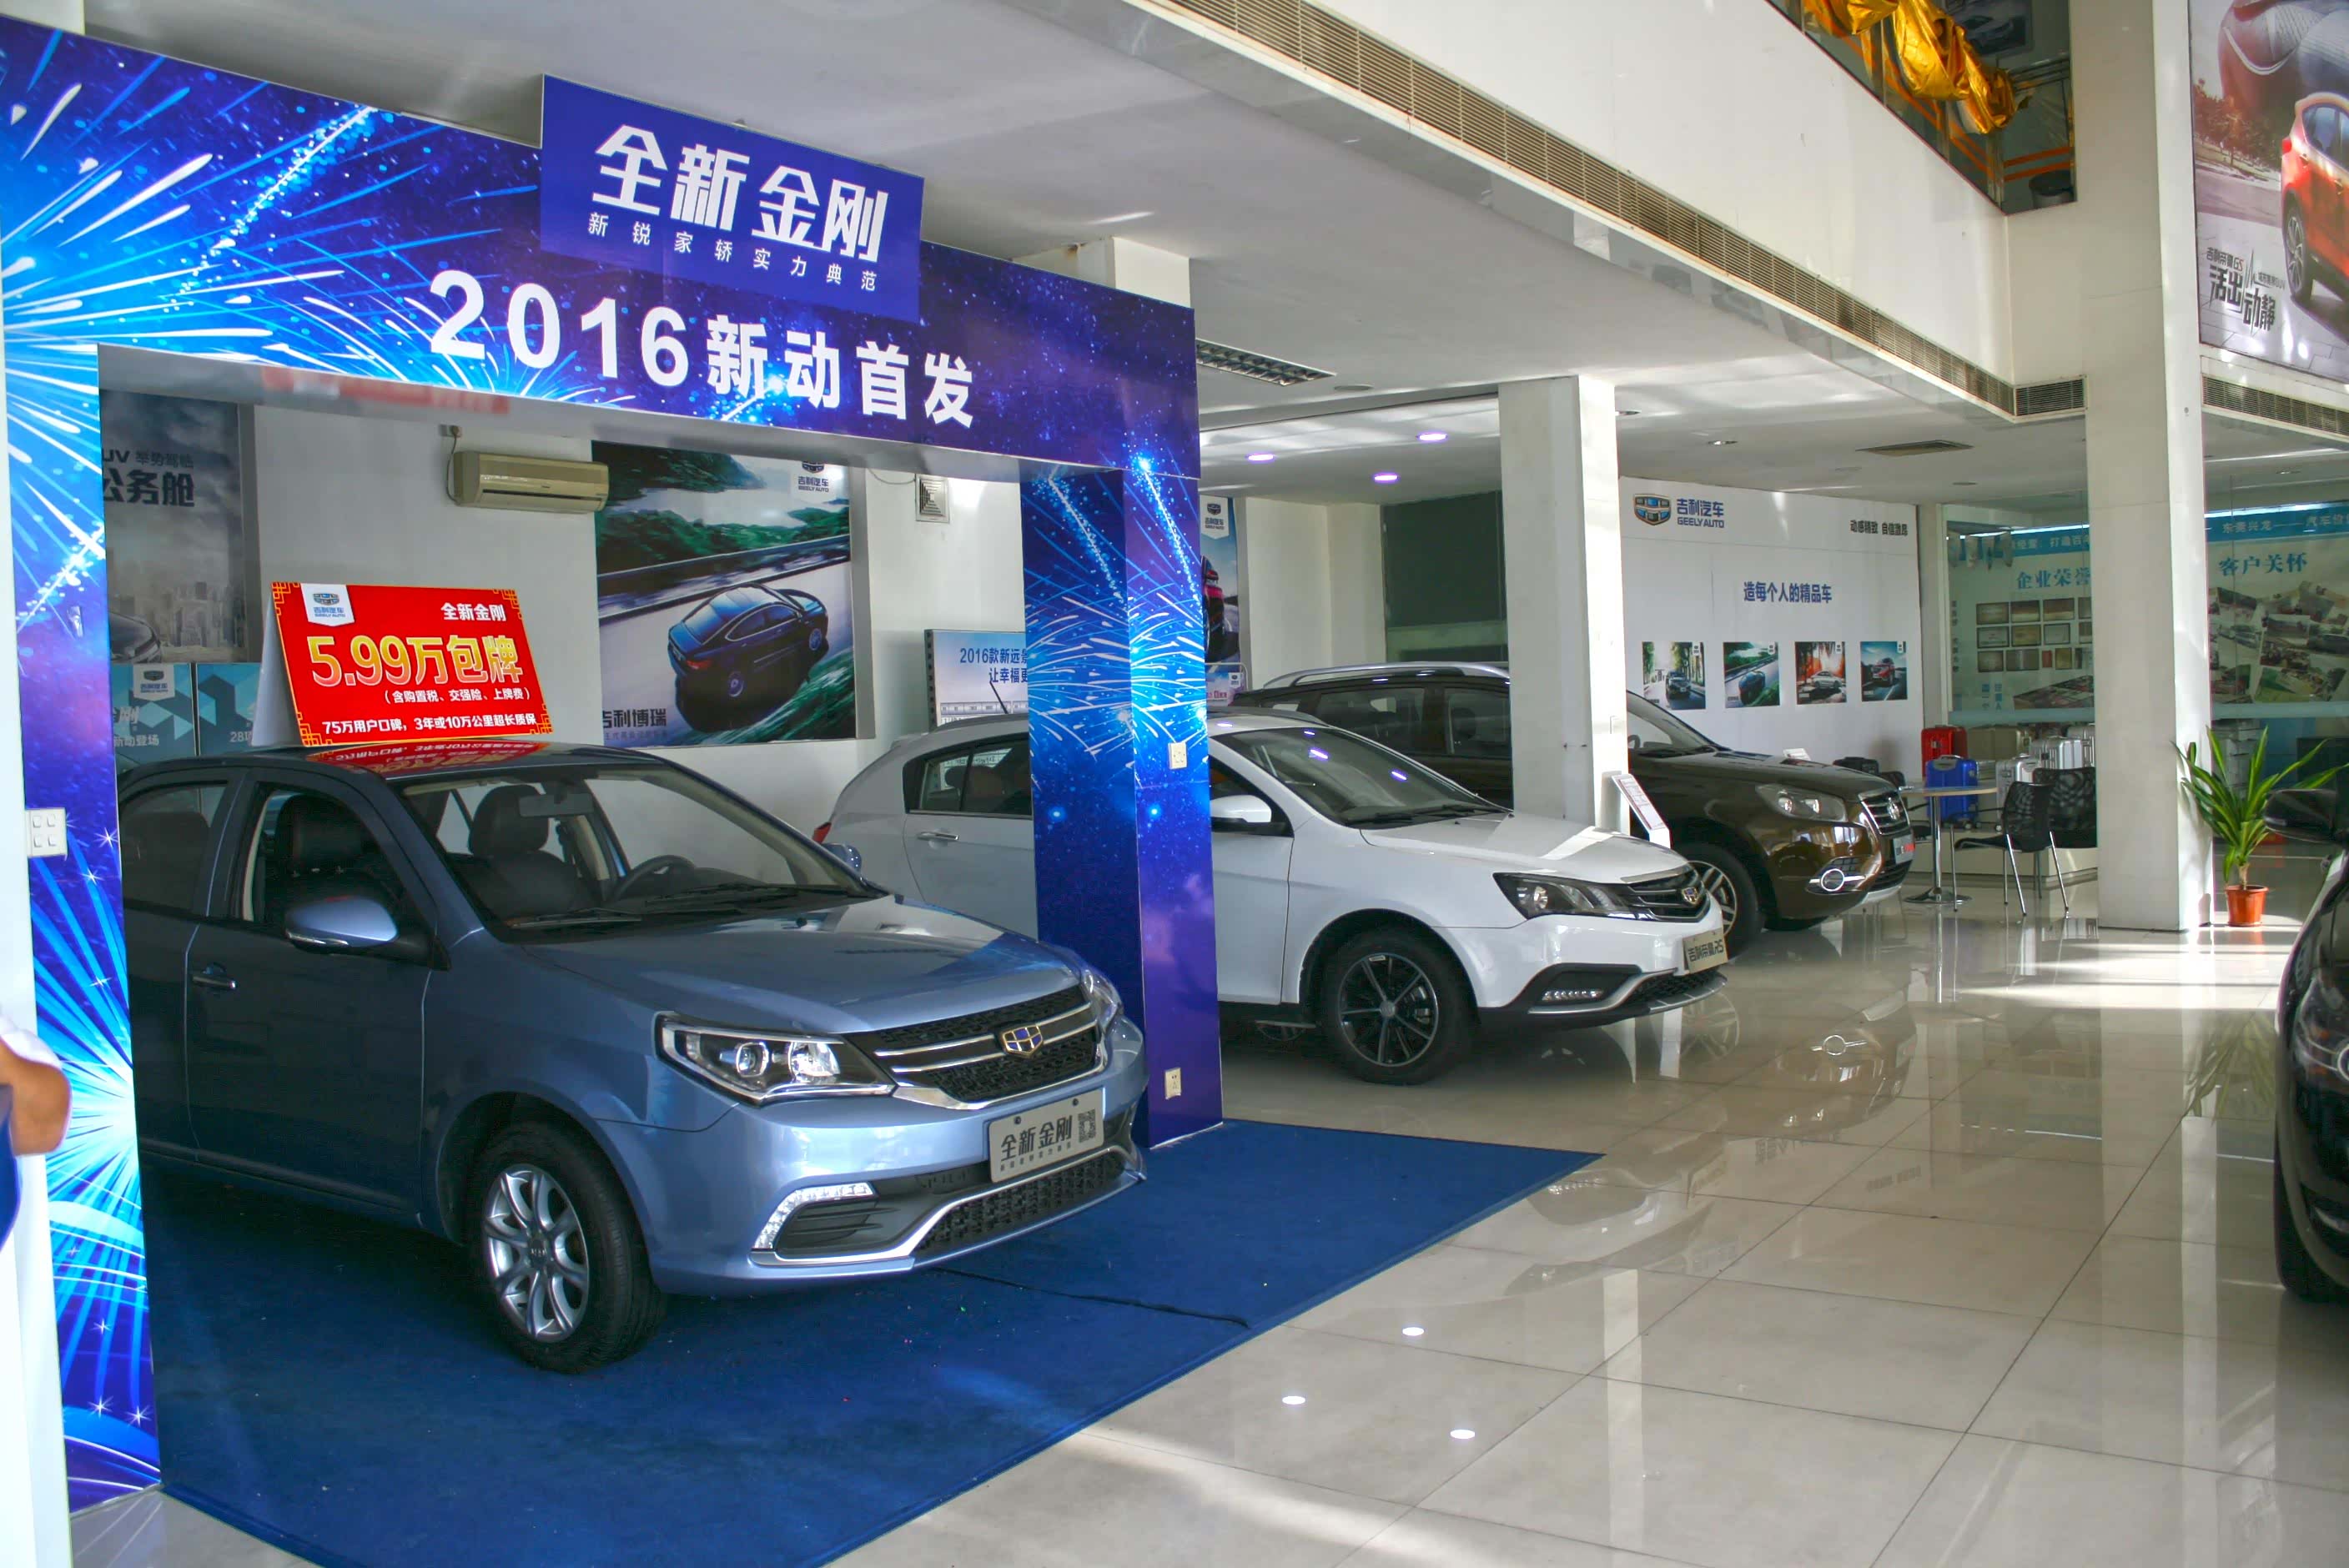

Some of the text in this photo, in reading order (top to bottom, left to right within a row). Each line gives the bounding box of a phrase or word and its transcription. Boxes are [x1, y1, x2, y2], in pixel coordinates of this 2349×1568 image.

[591, 124, 888, 263] 全新金刚
[588, 212, 878, 292] 新锐家轿实力典范
[2209, 264, 2276, 331] 活出 动静
[430, 269, 973, 428] 2016新动首发
[1677, 499, 1724, 517] 吉利汽车
[1677, 517, 1724, 528] GEELY AUTO
[2219, 552, 2307, 576] 客户关怀
[440, 603, 506, 621] 全新金刚
[1743, 581, 1832, 603] 造每个人的精品车
[307, 635, 523, 687] 5.99万包牌
[1001, 1115, 1073, 1162] 全新金刚
